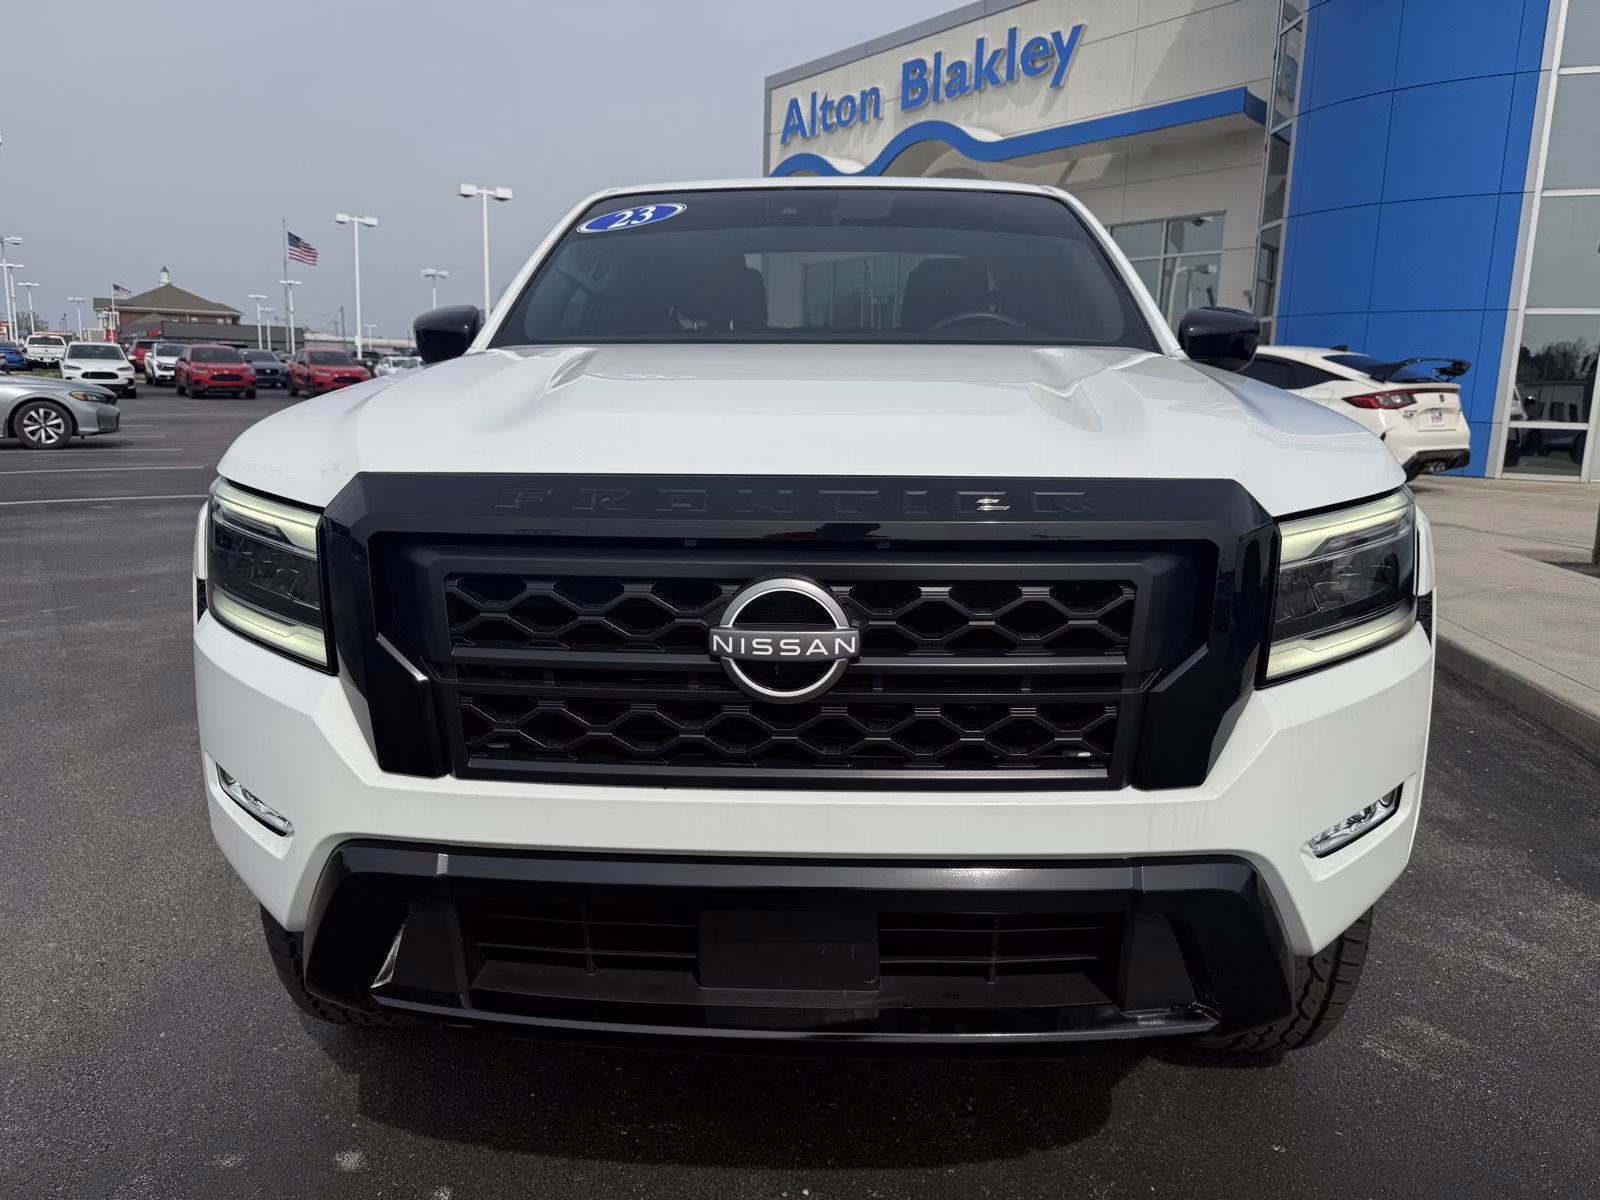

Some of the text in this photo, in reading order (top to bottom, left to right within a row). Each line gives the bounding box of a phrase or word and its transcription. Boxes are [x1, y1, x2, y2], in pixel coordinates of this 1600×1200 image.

[780, 24, 1085, 145] Alton Blakley
[607, 206, 657, 229] 23
[493, 488, 1095, 513] FRONTIER
[712, 634, 857, 656] NISSAN
